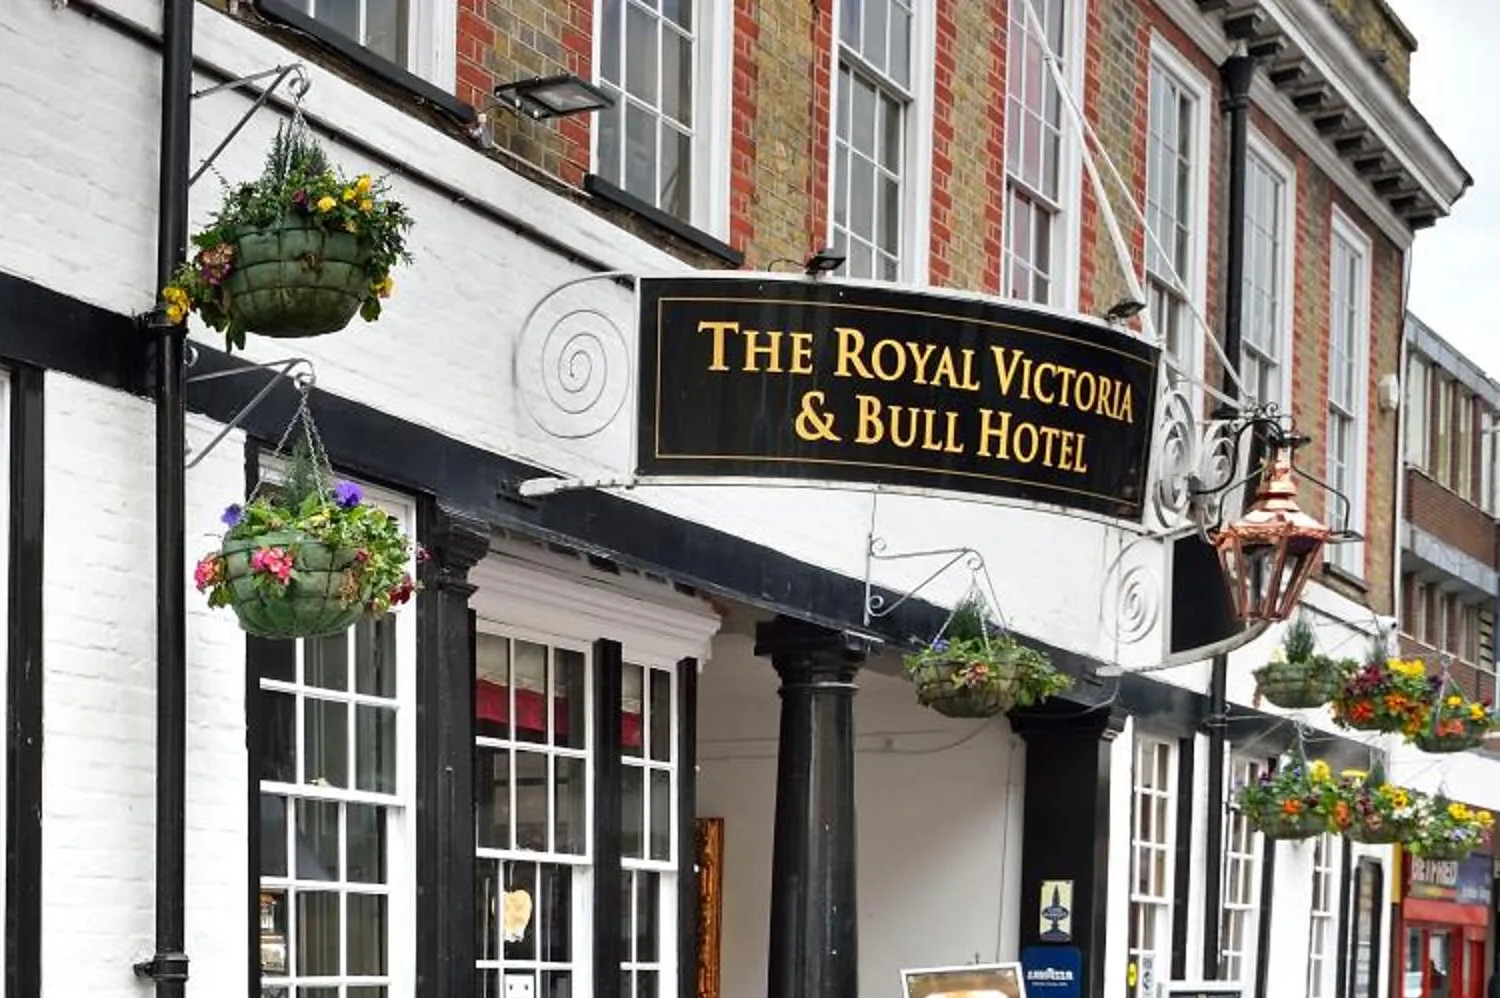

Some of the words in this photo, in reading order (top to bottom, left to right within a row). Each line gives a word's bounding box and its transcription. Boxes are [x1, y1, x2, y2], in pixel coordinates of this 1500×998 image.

[697, 321, 813, 375] THE
[833, 327, 980, 391] ROYAL
[989, 345, 1134, 424] VICTORIA
[795, 390, 842, 441] &
[854, 394, 964, 454] BULL
[976, 407, 1088, 473] HOTEL
